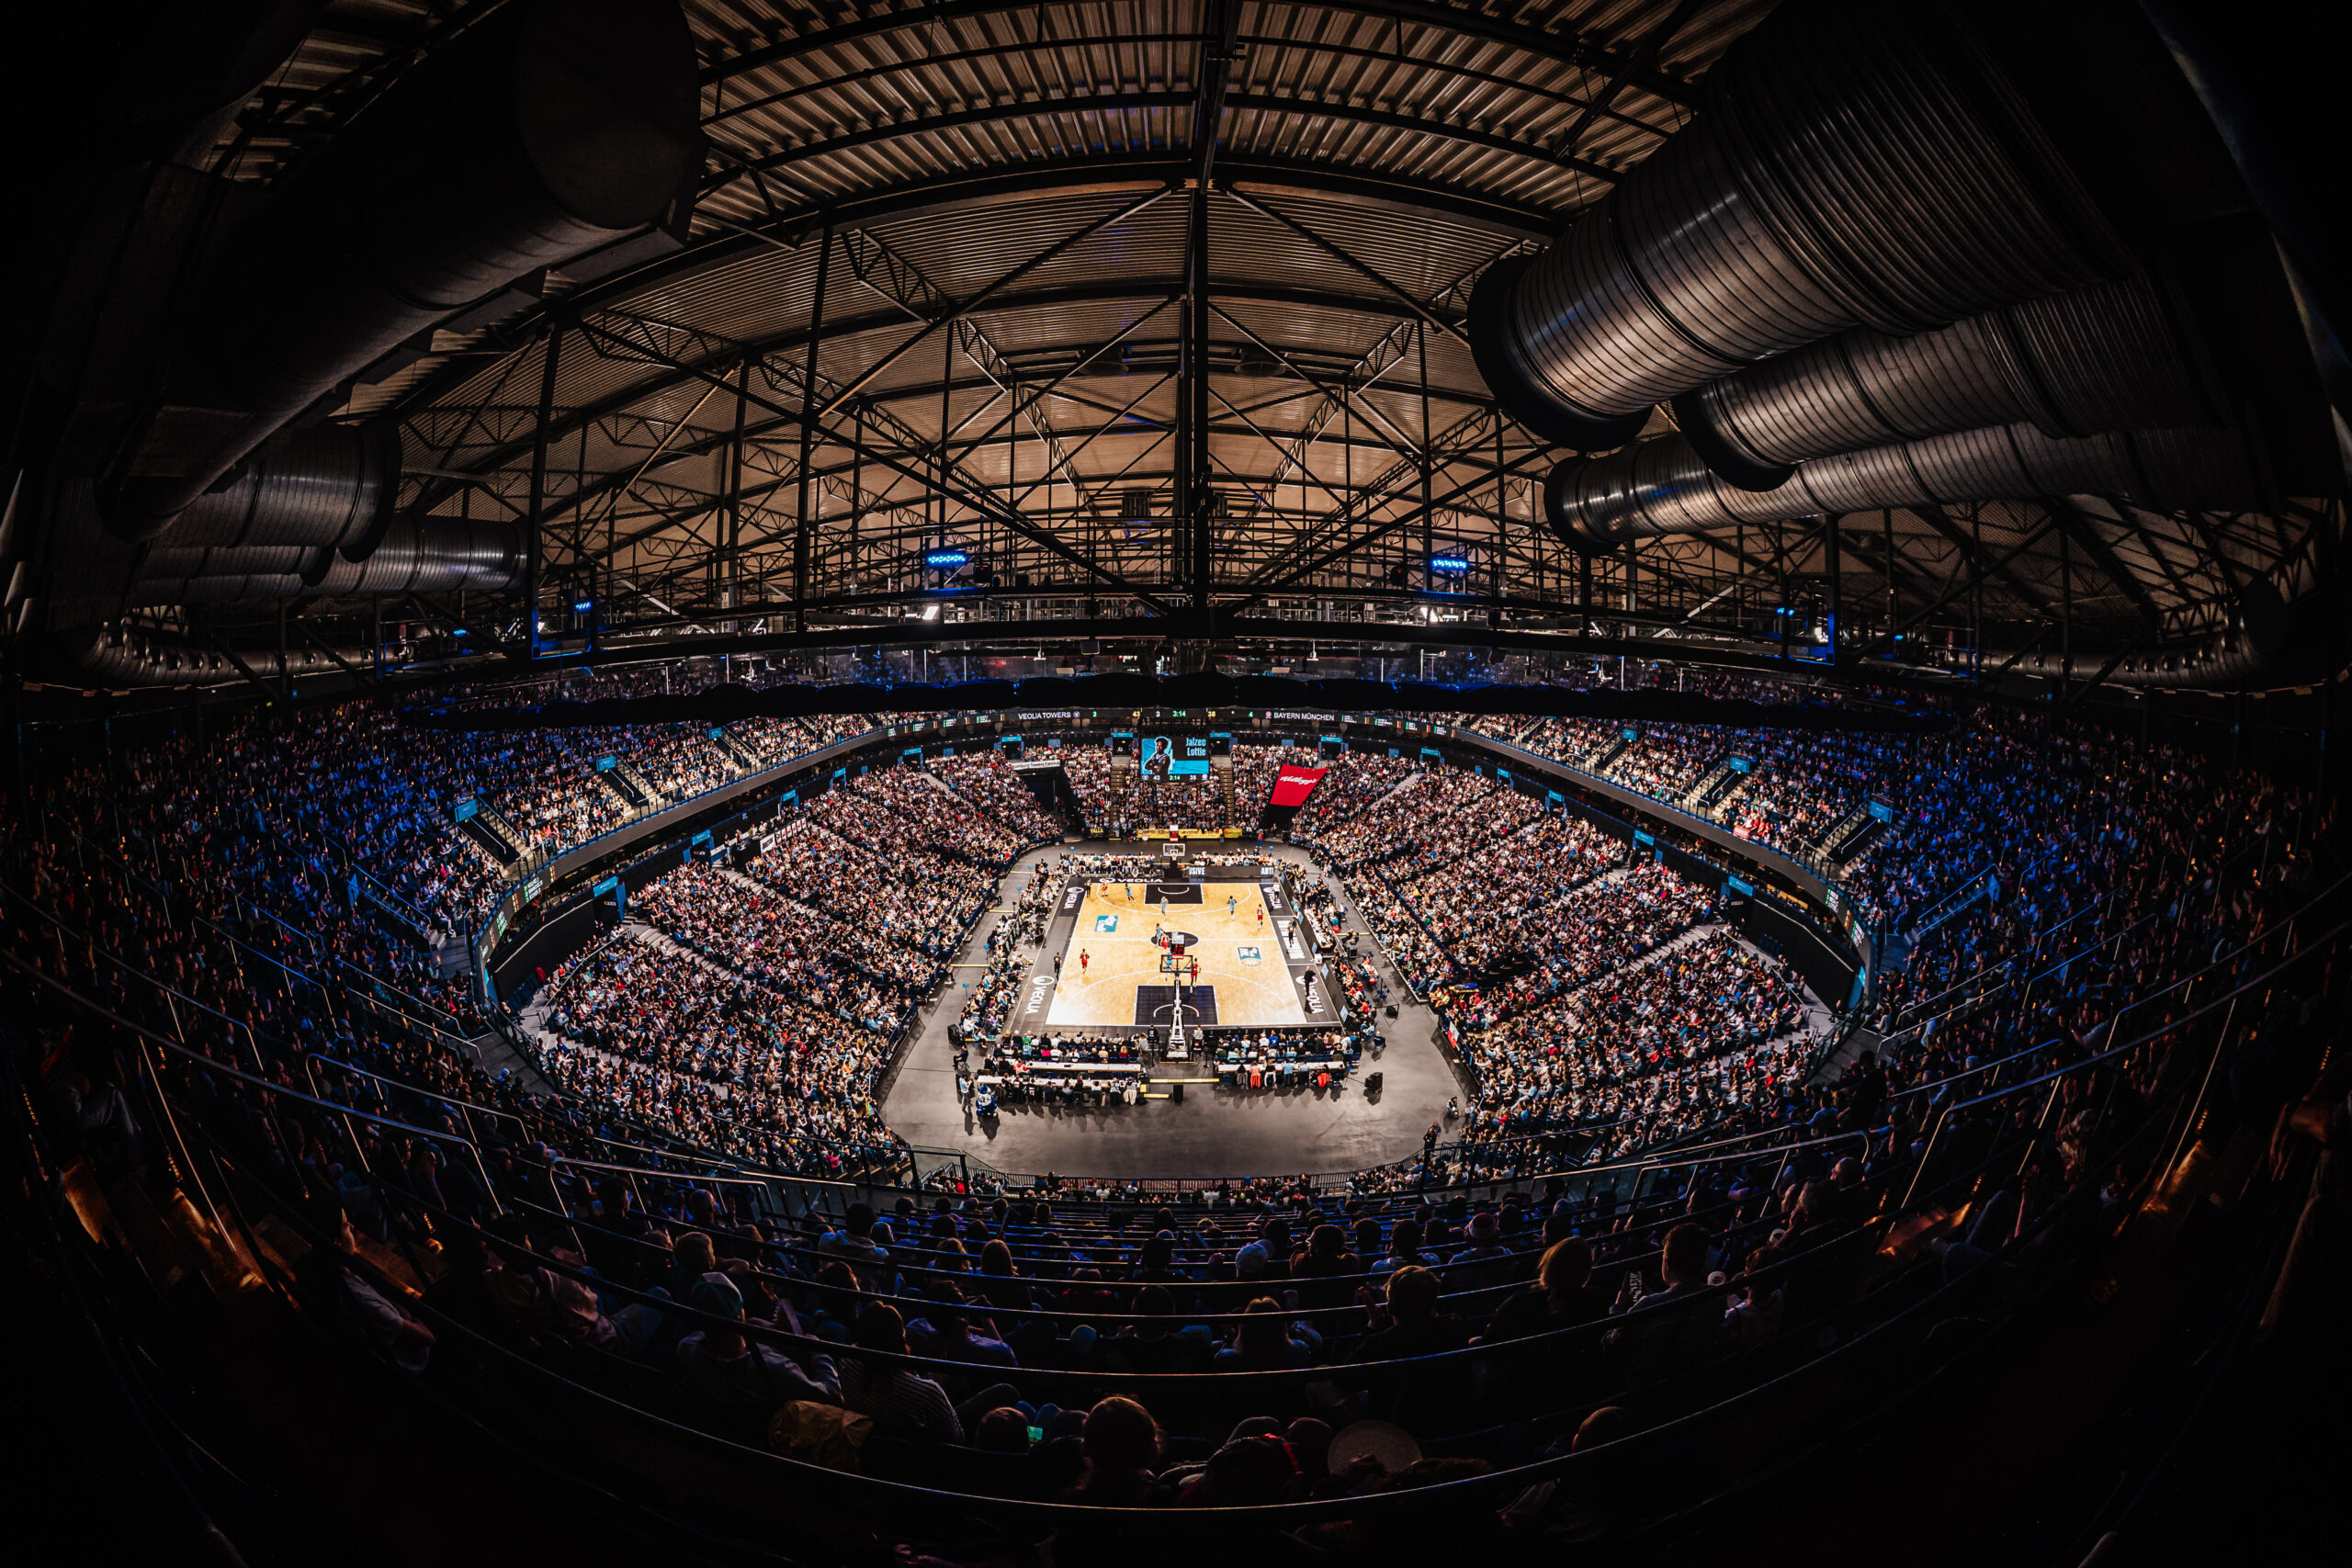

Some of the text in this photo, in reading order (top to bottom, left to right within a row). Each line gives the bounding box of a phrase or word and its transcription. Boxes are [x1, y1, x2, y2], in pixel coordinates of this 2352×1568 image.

[1301, 713, 1335, 721] MÜNCHEN
[1187, 747, 1206, 756] Lottie
[1064, 893, 1078, 908] VEOLIA
[1026, 986, 1046, 1014] VEOLIA
